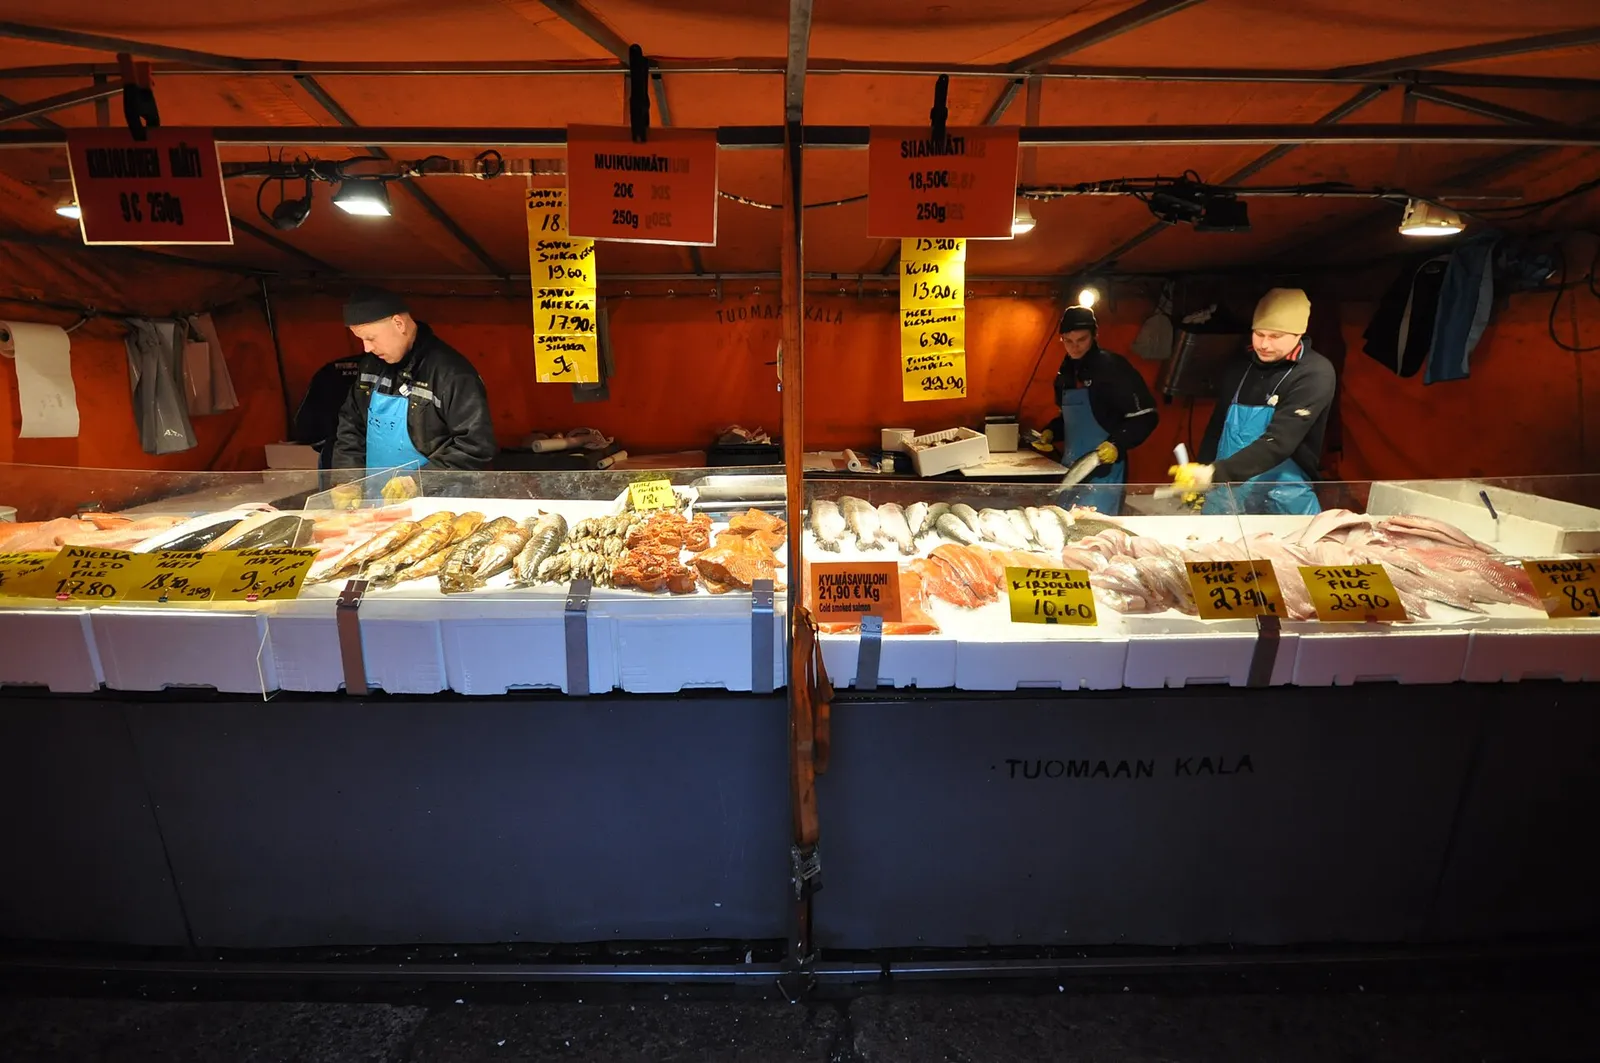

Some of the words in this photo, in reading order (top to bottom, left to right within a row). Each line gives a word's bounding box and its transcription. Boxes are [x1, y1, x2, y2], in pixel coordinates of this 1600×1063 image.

[901, 135, 965, 158] SIIANMÄTI
[595, 153, 668, 173] MUIKUNMÄTI
[909, 170, 948, 192] 18,50€
[613, 183, 634, 199] 20€
[612, 210, 639, 228] 250g
[916, 203, 946, 223] 250g
[715, 305, 783, 324] TUOMAA
[805, 306, 843, 325] KALA
[70, 570, 108, 578] FILE
[818, 571, 888, 586] KYLMÄSAVULOHI
[1026, 569, 1070, 581] MERI
[55, 579, 117, 598] 17.80
[1032, 589, 1067, 597] FILE
[1327, 580, 1371, 589] FILE
[819, 586, 850, 602] 21,90
[853, 586, 861, 599] €
[864, 586, 880, 602] Kg
[819, 603, 831, 613] Cold
[832, 603, 851, 612] smoked
[853, 603, 871, 612] salmon
[1034, 599, 1093, 619] 10.60
[1005, 758, 1155, 779] TUOMAAN
[1175, 754, 1255, 777] KALA
